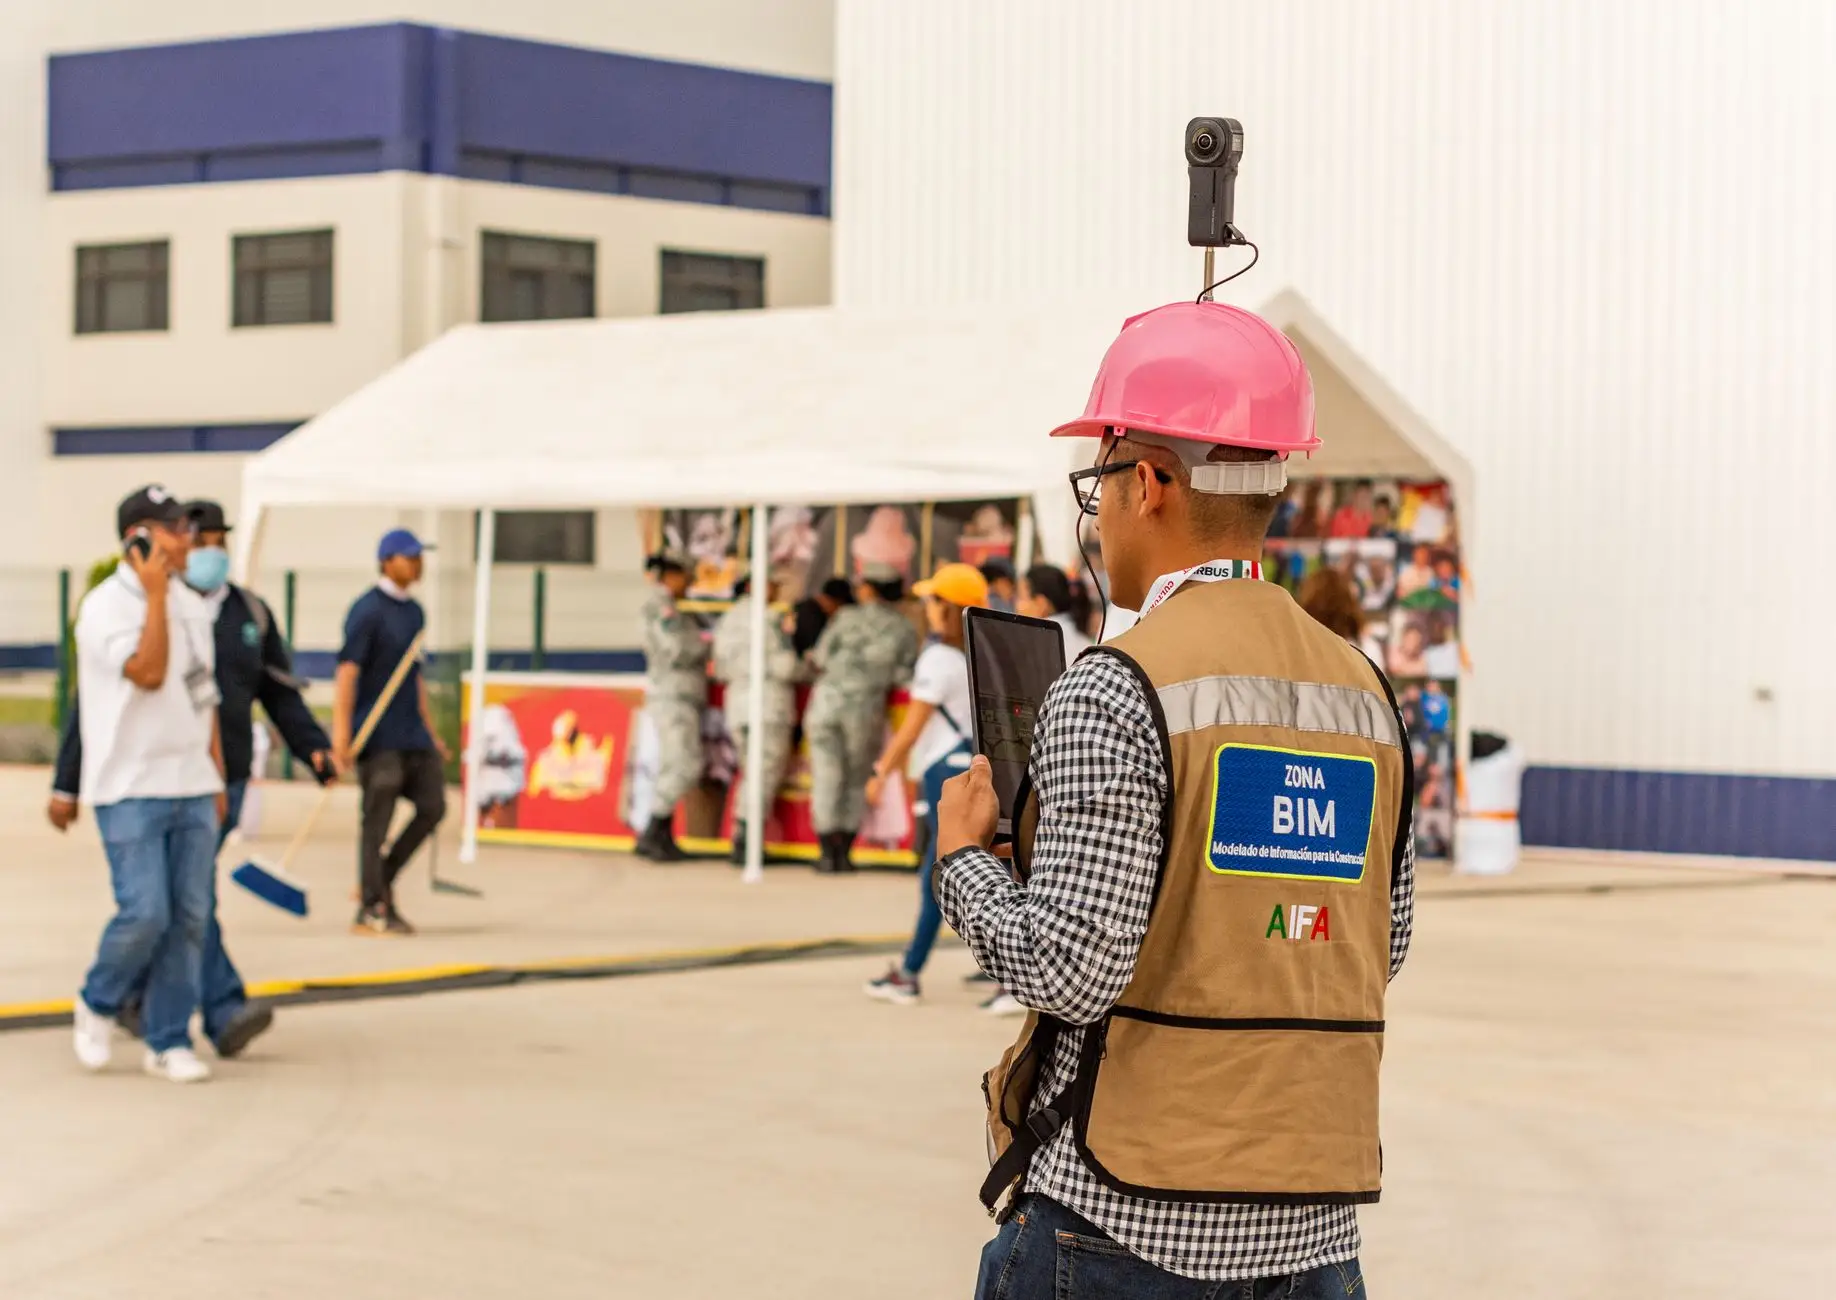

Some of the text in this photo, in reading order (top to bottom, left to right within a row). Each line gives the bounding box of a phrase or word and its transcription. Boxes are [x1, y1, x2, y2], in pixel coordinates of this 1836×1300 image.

[1284, 764, 1326, 790] ZONA
[1272, 795, 1336, 838] BIM
[1212, 841, 1258, 857] Modelado
[1258, 845, 1269, 858] de
[1270, 845, 1312, 861] Información
[1312, 850, 1329, 864] para
[1329, 850, 1335, 863] la
[1265, 903, 1330, 941] AIFA
